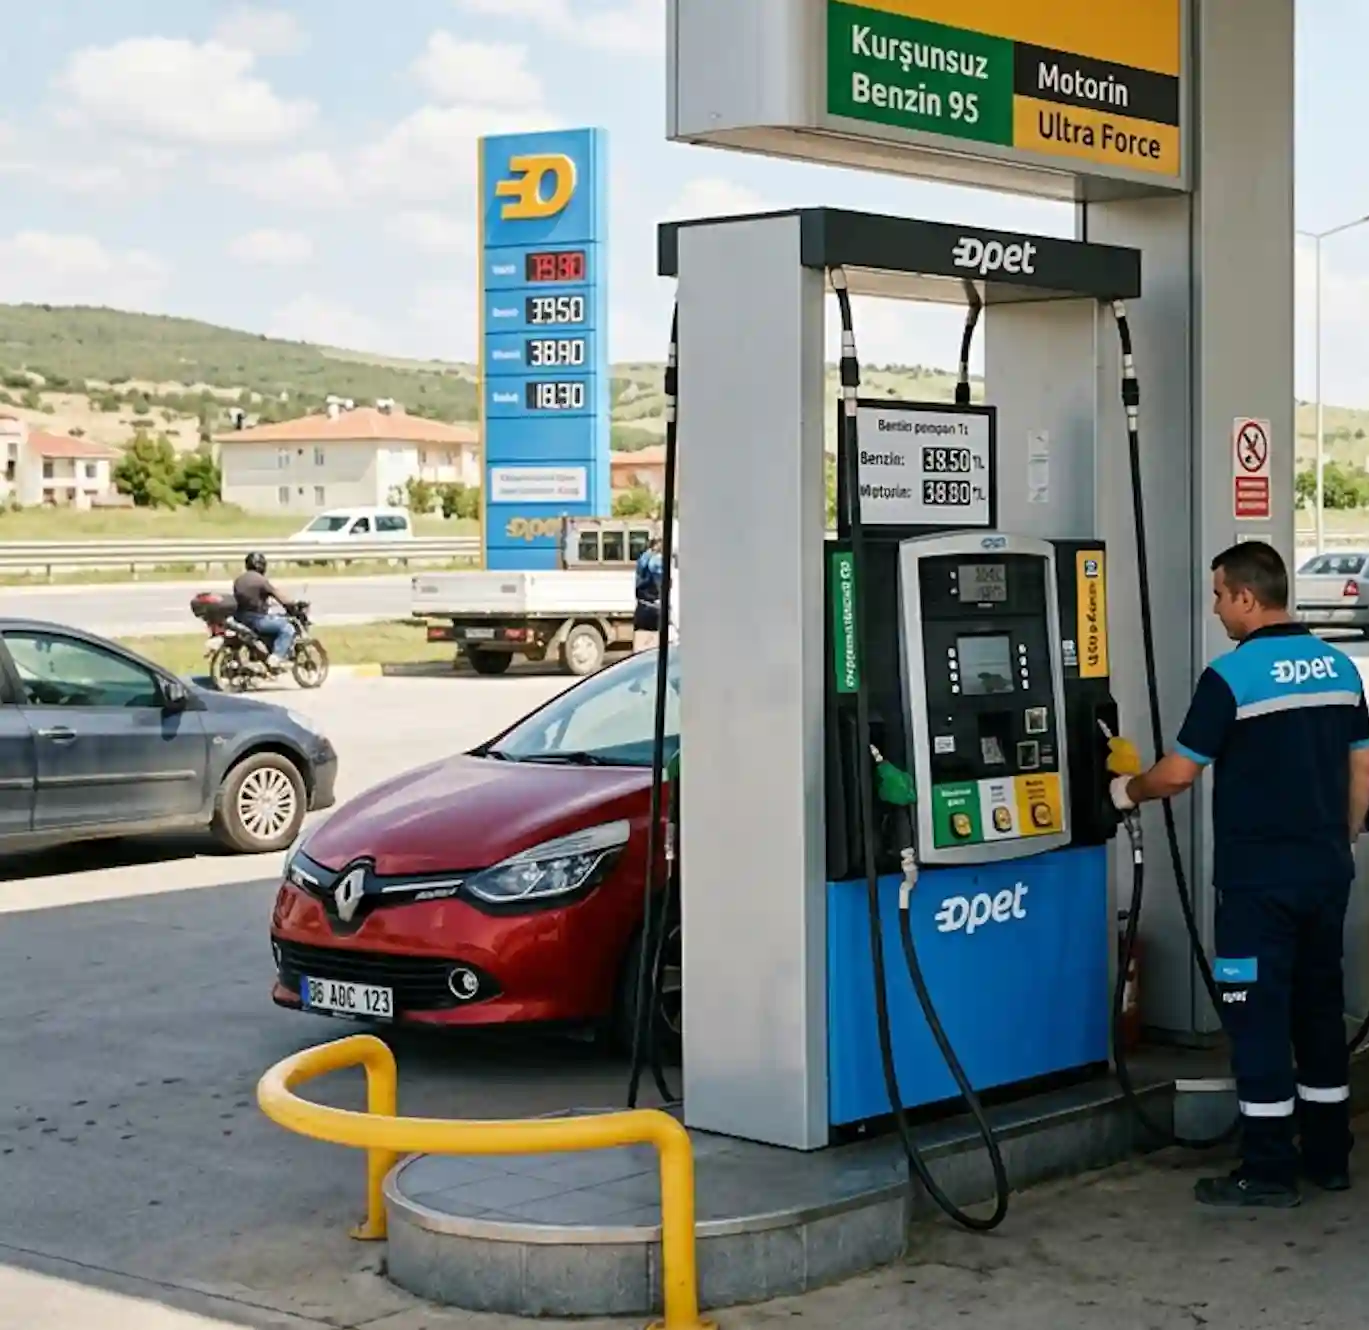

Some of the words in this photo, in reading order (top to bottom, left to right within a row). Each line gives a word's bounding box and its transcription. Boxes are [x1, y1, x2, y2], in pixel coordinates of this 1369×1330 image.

[851, 24, 989, 80] Kurşunsuz
[852, 72, 941, 117] Benzin
[949, 91, 979, 124] 95
[1037, 62, 1129, 106] Motorin
[1038, 110, 1095, 146] Ultra
[1101, 124, 1161, 159] Force
[363, 987, 390, 1013] 123
